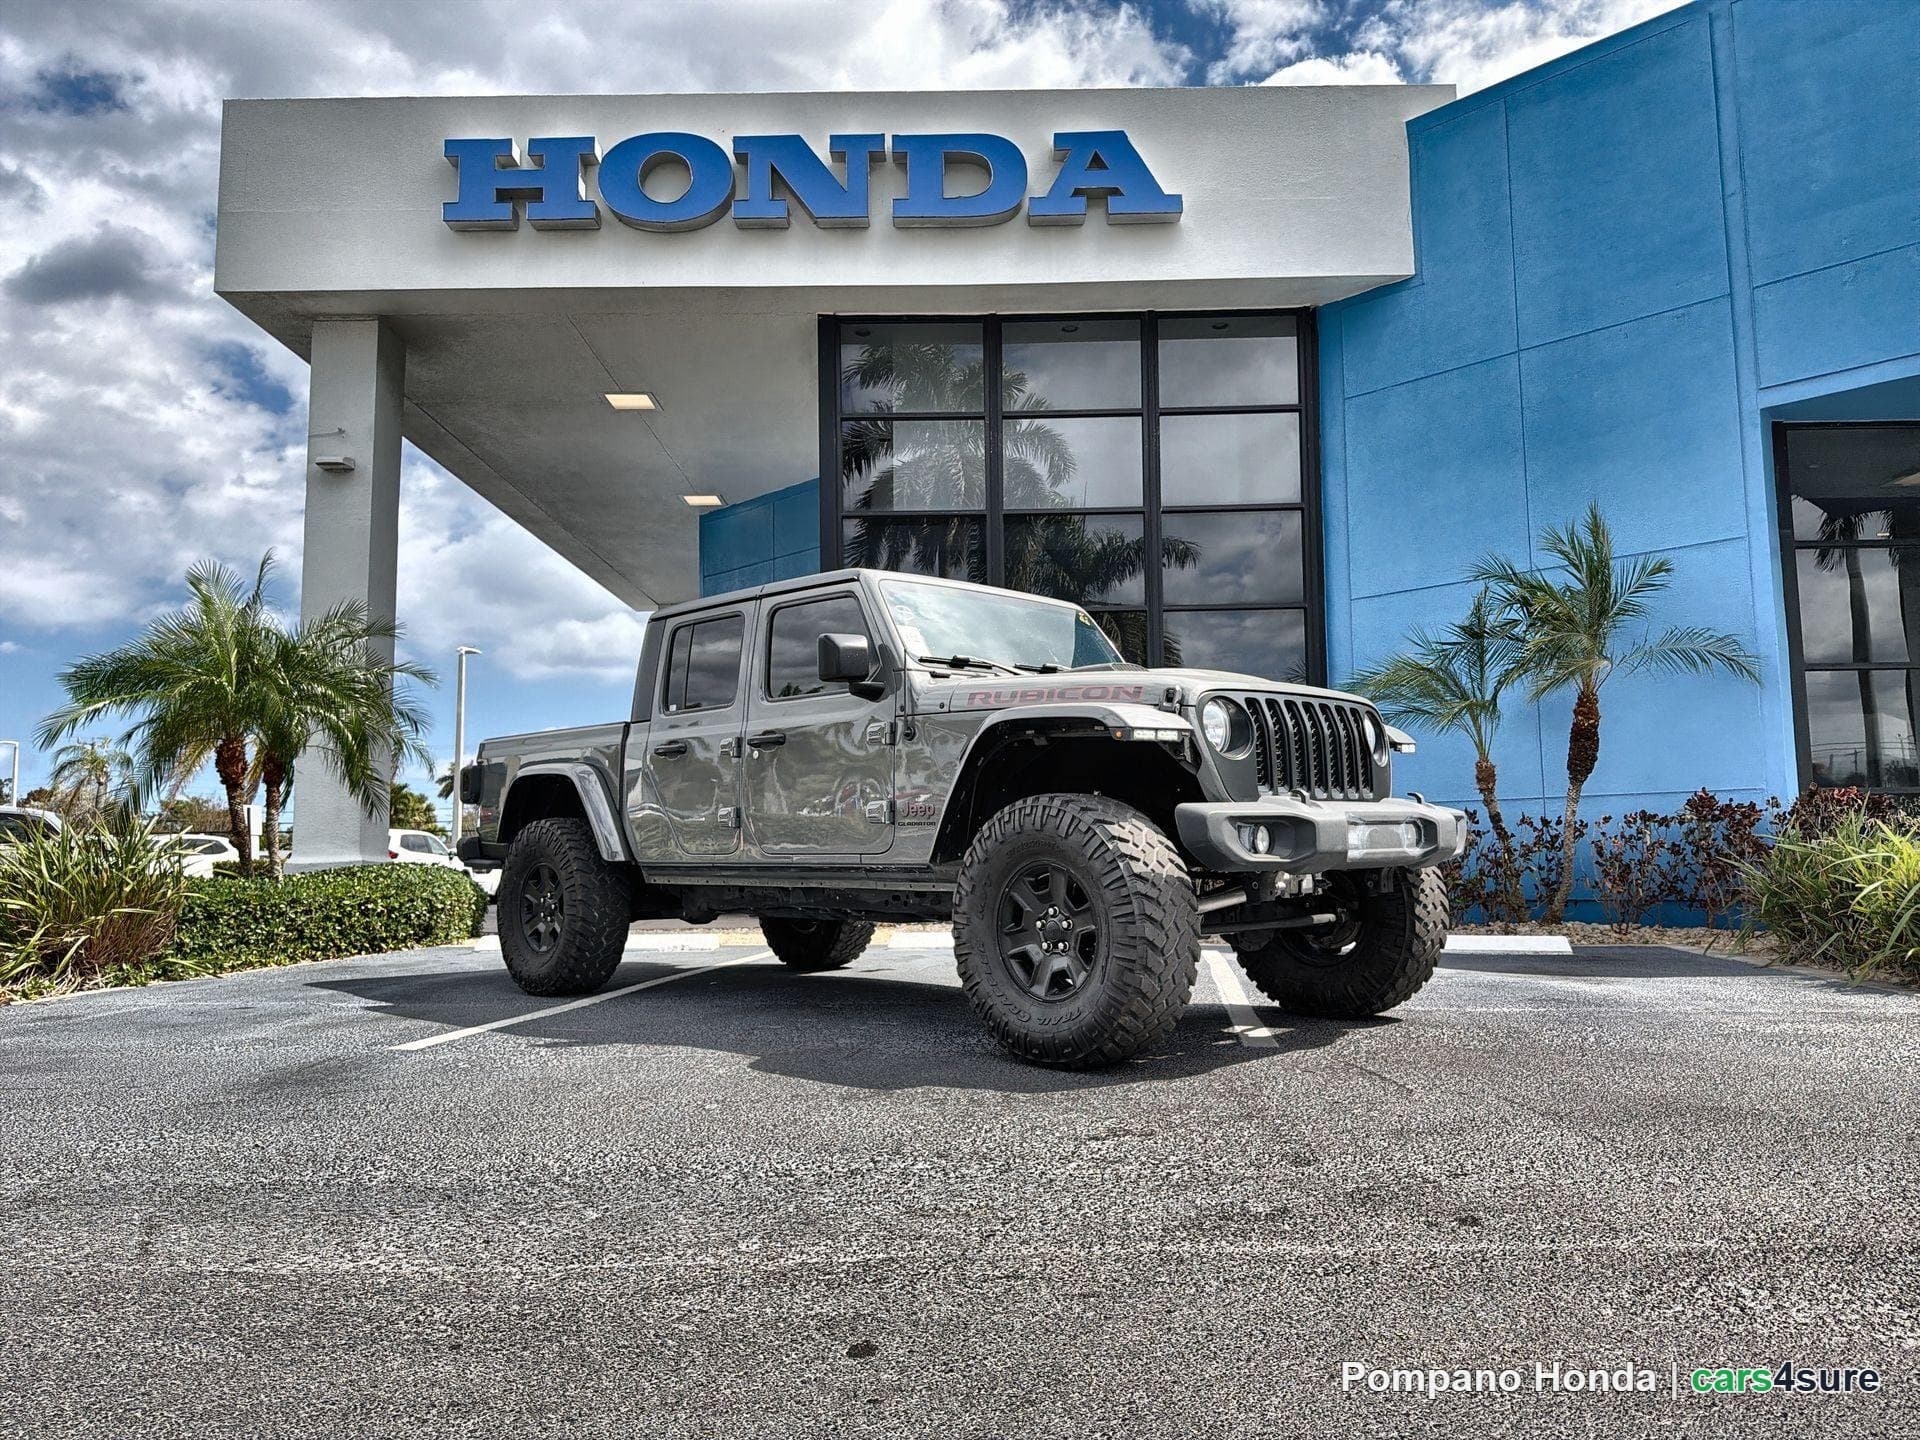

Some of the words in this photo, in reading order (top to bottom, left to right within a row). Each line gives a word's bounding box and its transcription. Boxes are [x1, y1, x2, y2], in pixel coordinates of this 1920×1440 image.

[442, 129, 1183, 232] HONDA
[967, 685, 1144, 706] RUBICON
[902, 801, 936, 819] Jeep
[1037, 1007, 1082, 1026] TRAIL
